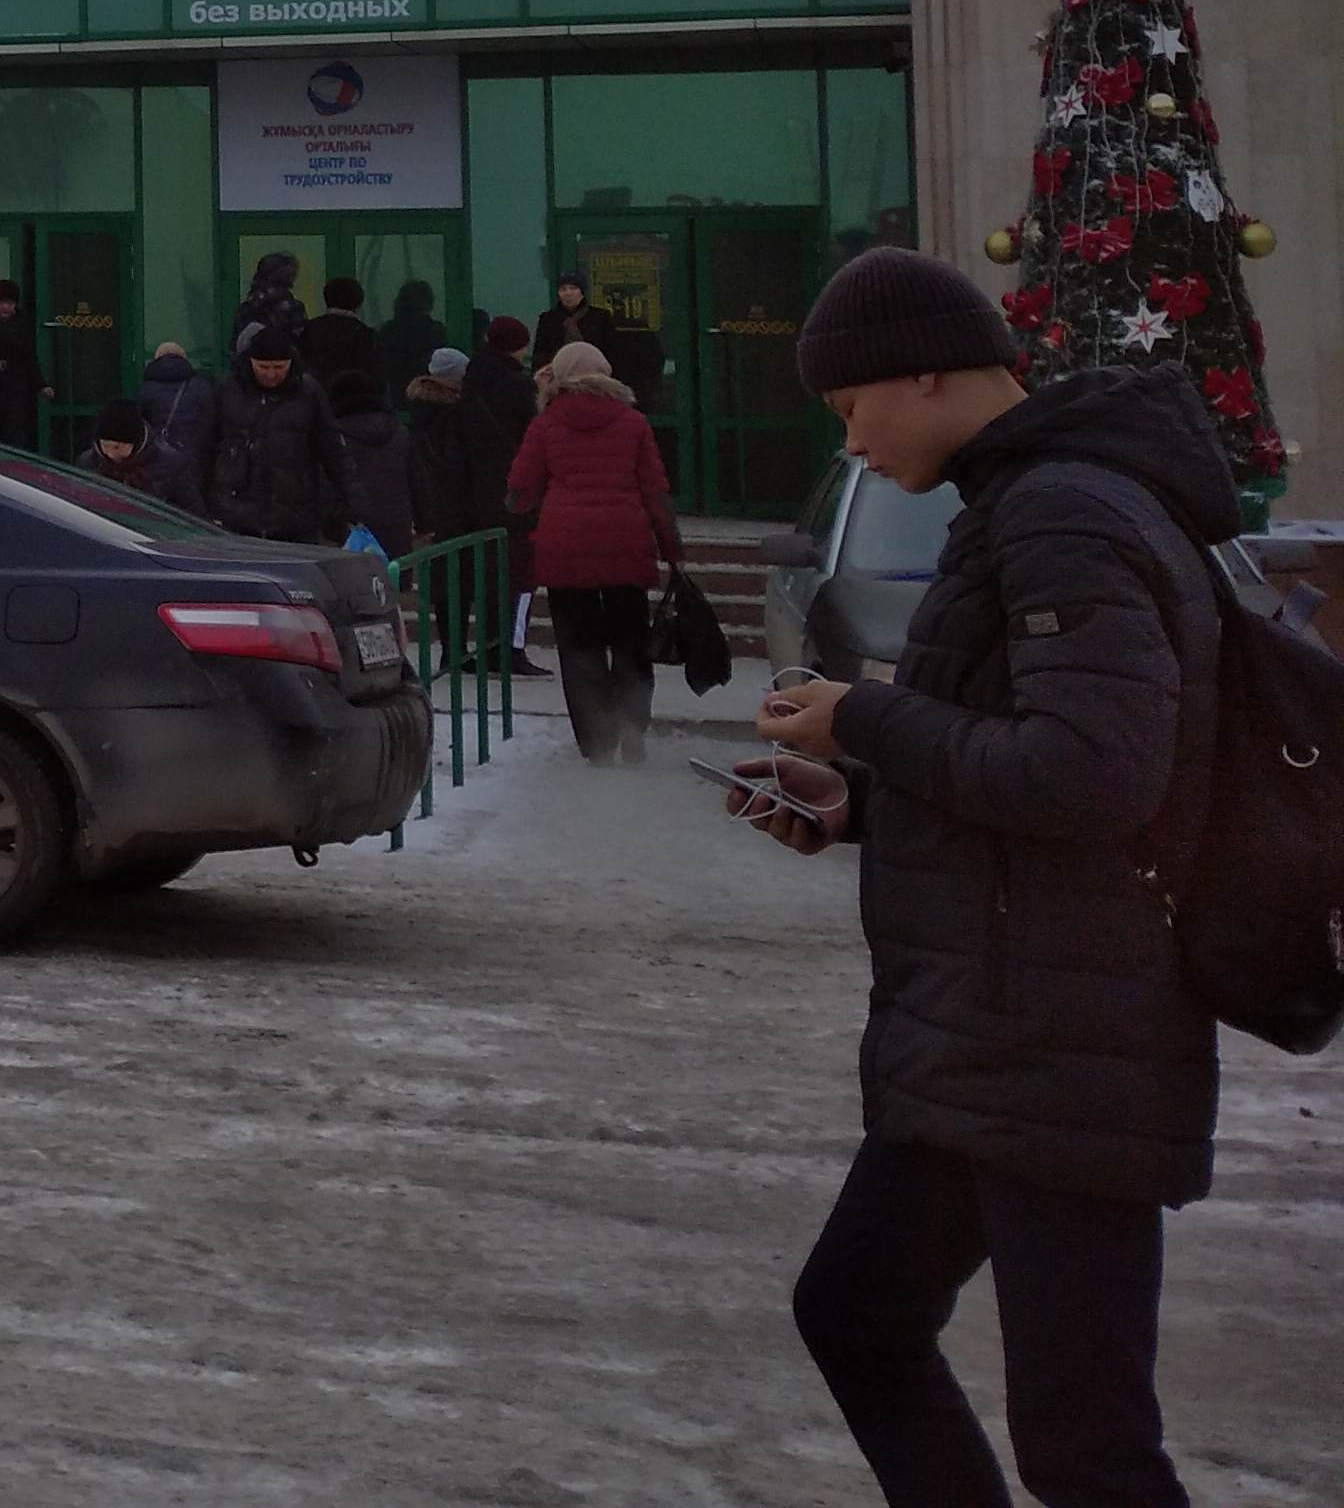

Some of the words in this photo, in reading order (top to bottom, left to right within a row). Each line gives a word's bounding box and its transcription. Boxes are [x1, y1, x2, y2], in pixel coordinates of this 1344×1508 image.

[189, 0, 240, 25] без
[308, 157, 345, 171] ЦЕНТР
[349, 157, 367, 168] ПО
[283, 171, 393, 188] ТРУДОУСТРОЙСТВУ
